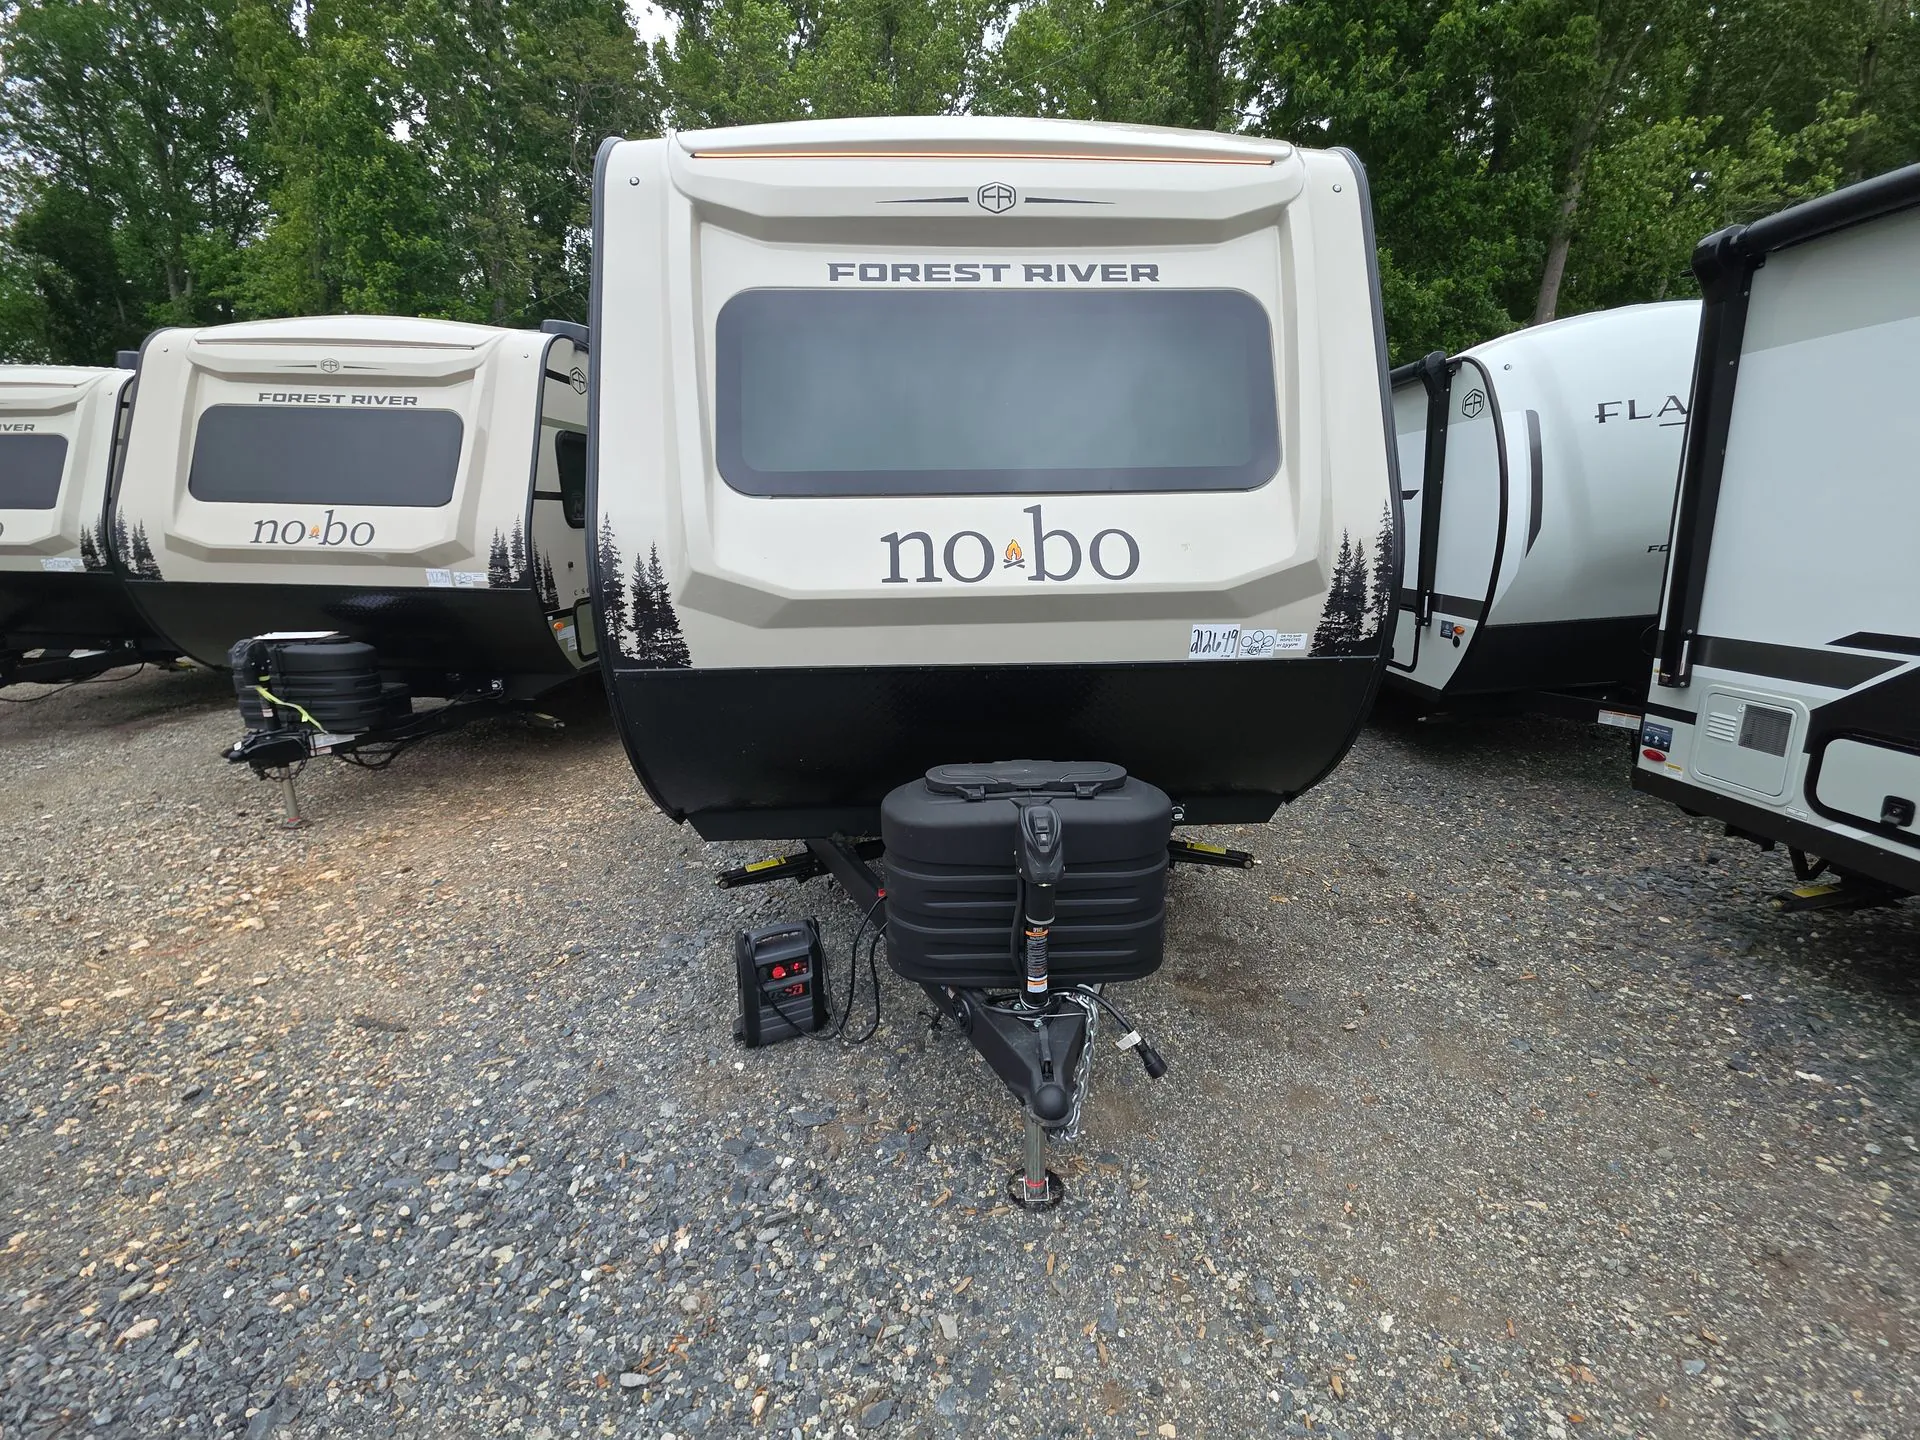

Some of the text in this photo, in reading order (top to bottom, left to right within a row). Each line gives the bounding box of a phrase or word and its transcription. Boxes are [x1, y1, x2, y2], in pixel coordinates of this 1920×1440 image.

[826, 263, 1160, 282] FOREST RIVER
[258, 392, 418, 406] FOREST RIVER
